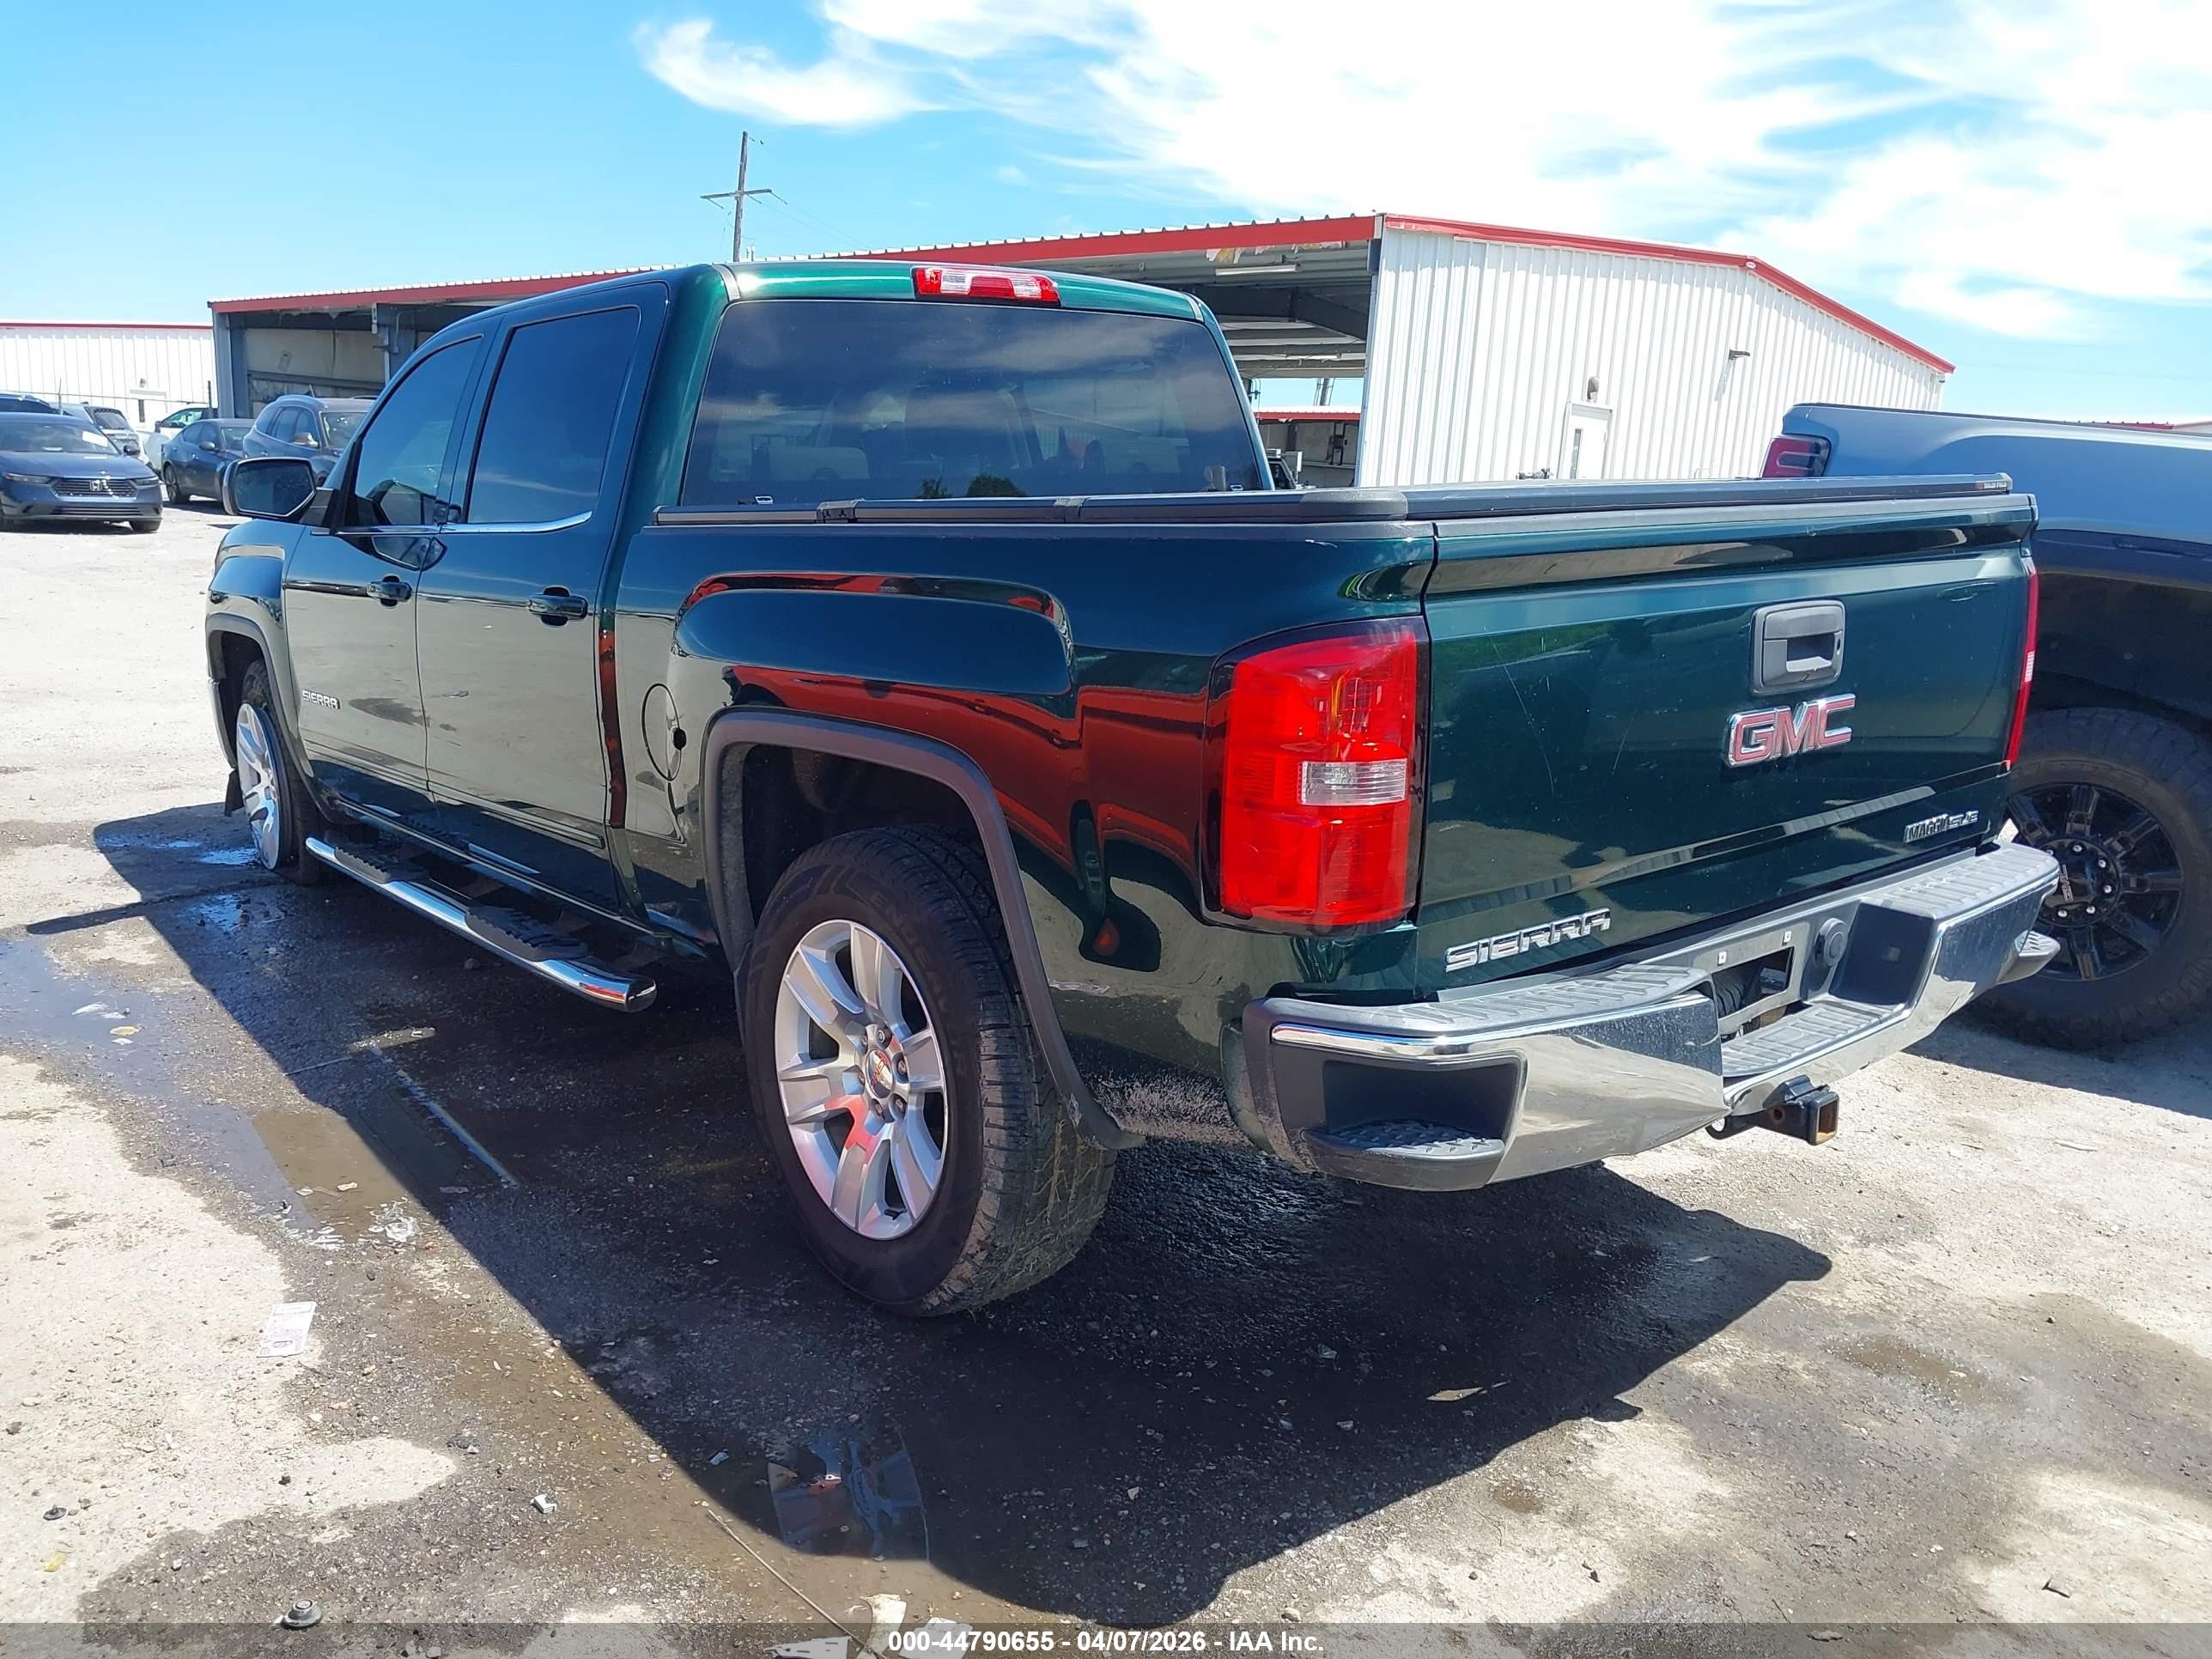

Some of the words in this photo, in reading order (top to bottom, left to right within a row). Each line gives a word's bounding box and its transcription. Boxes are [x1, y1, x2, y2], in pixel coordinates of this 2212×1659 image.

[302, 689, 339, 710] SIERRA
[1728, 693, 1856, 766] GMC
[1445, 907, 1610, 973] SIERRA
